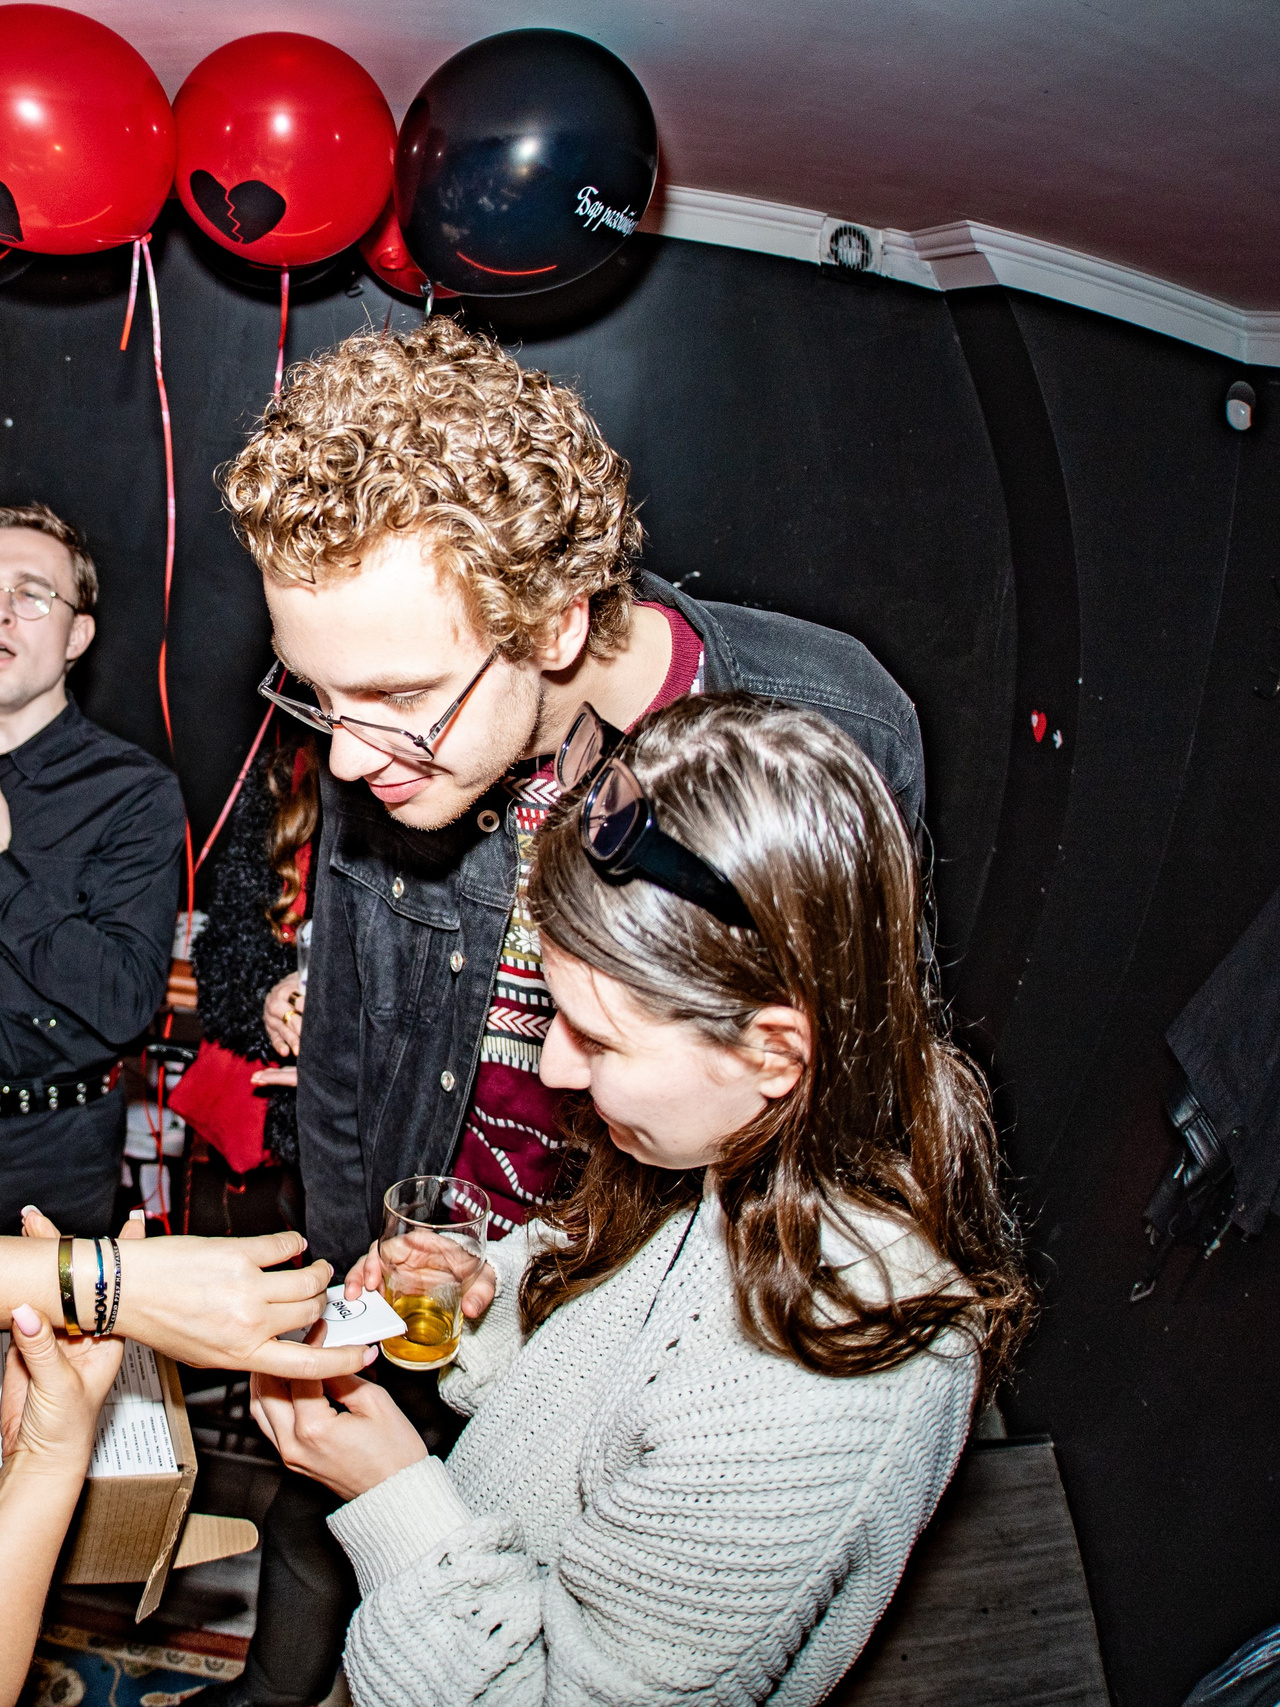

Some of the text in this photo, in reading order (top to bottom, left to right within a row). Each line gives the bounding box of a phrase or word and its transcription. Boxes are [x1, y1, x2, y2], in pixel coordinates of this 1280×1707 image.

[574, 185, 605, 228] Бар
[93, 1281, 107, 1324] LOVE
[110, 1304, 118, 1322] СВОЮ
[332, 1301, 353, 1319] BNGL
